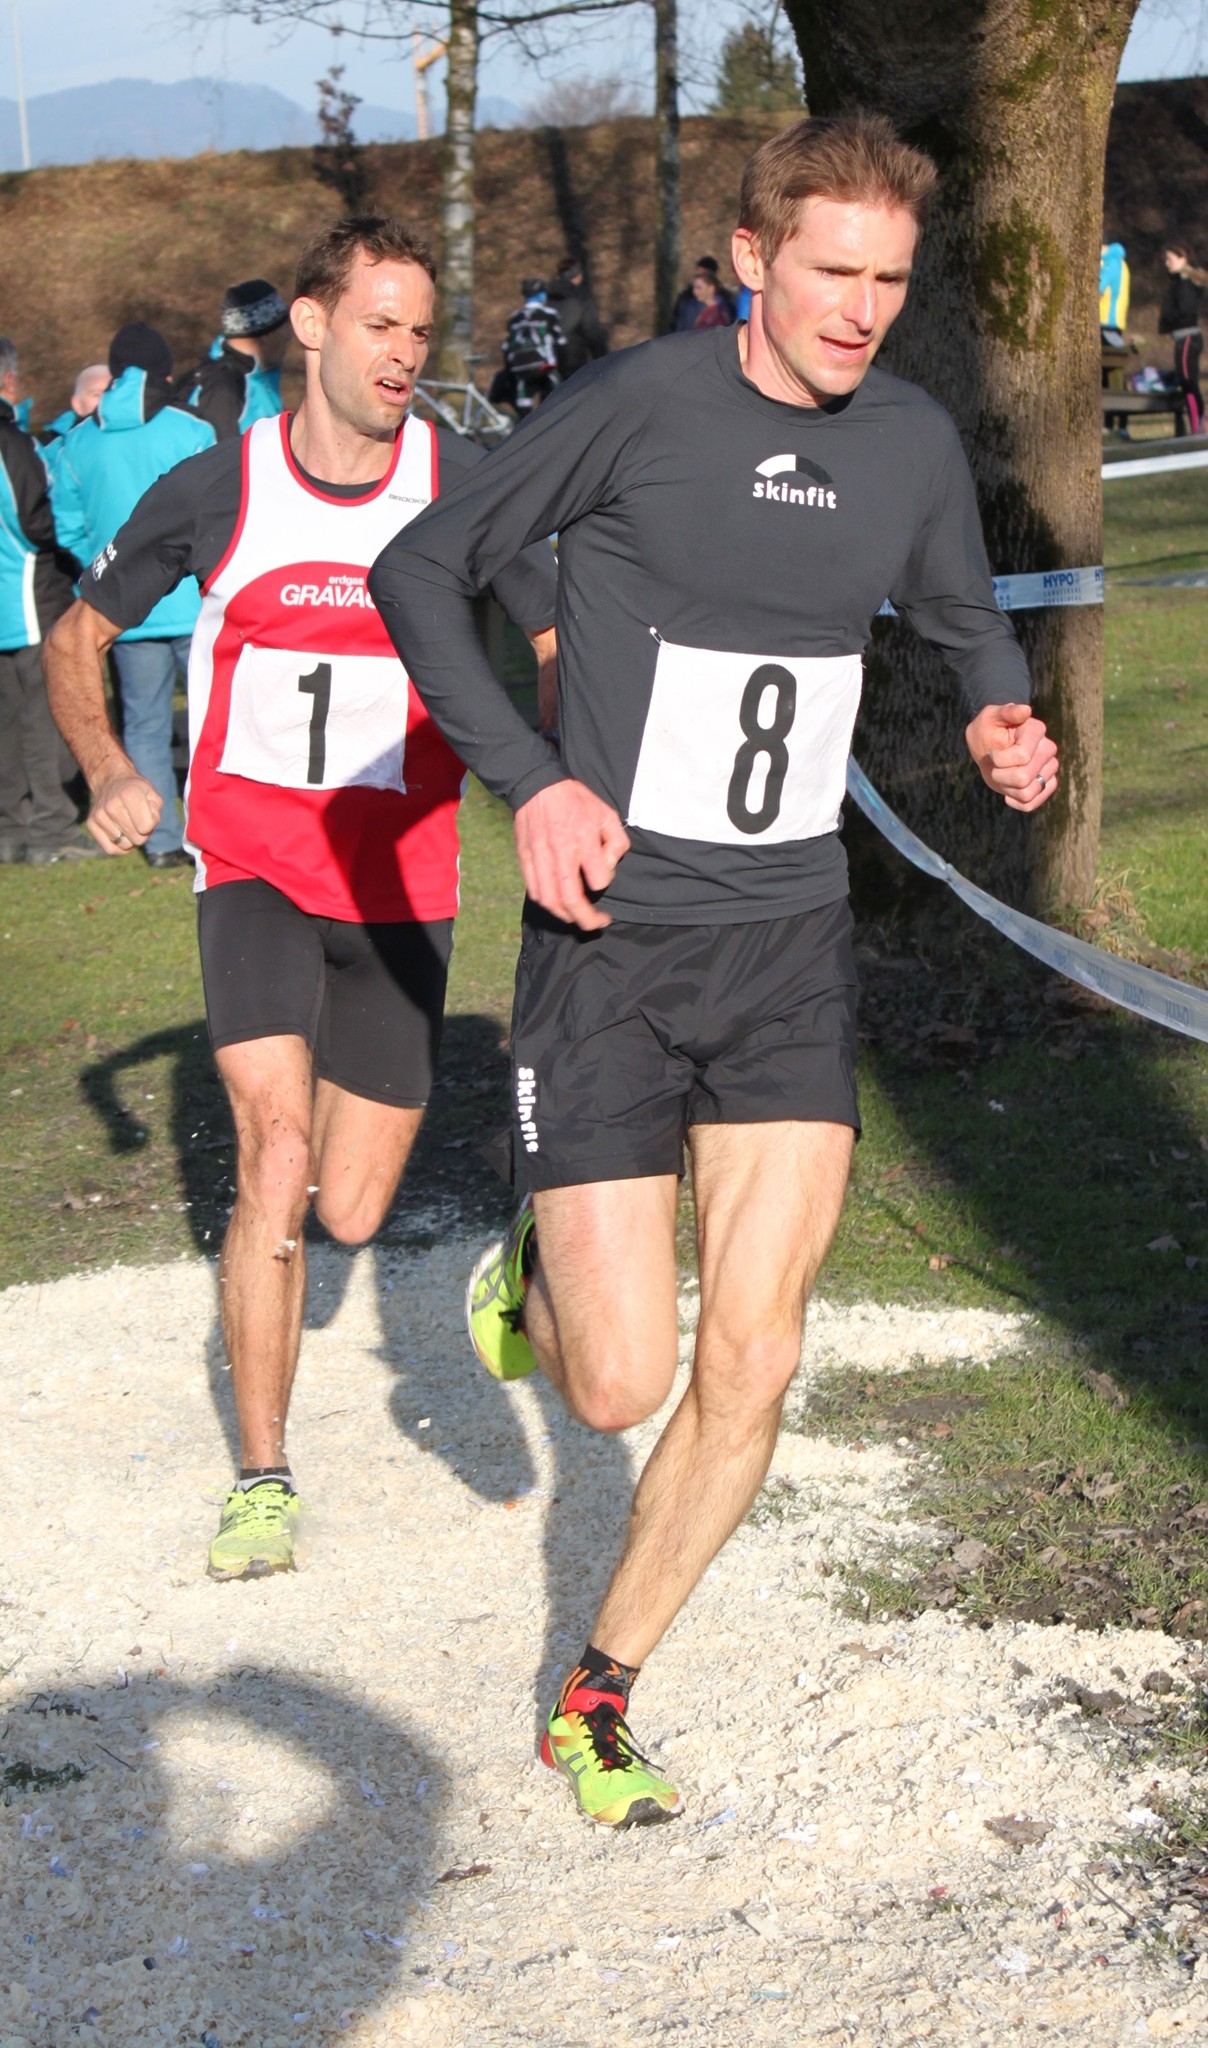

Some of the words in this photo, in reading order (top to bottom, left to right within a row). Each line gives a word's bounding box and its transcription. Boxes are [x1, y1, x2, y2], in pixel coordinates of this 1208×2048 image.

[388, 493, 428, 505] BROOKS
[752, 479, 837, 510] skinfit
[328, 574, 365, 586] erdgas
[1043, 572, 1074, 588] HYPO
[298, 662, 332, 784] 1
[726, 663, 797, 835] 8
[517, 1067, 540, 1153] skinfit
